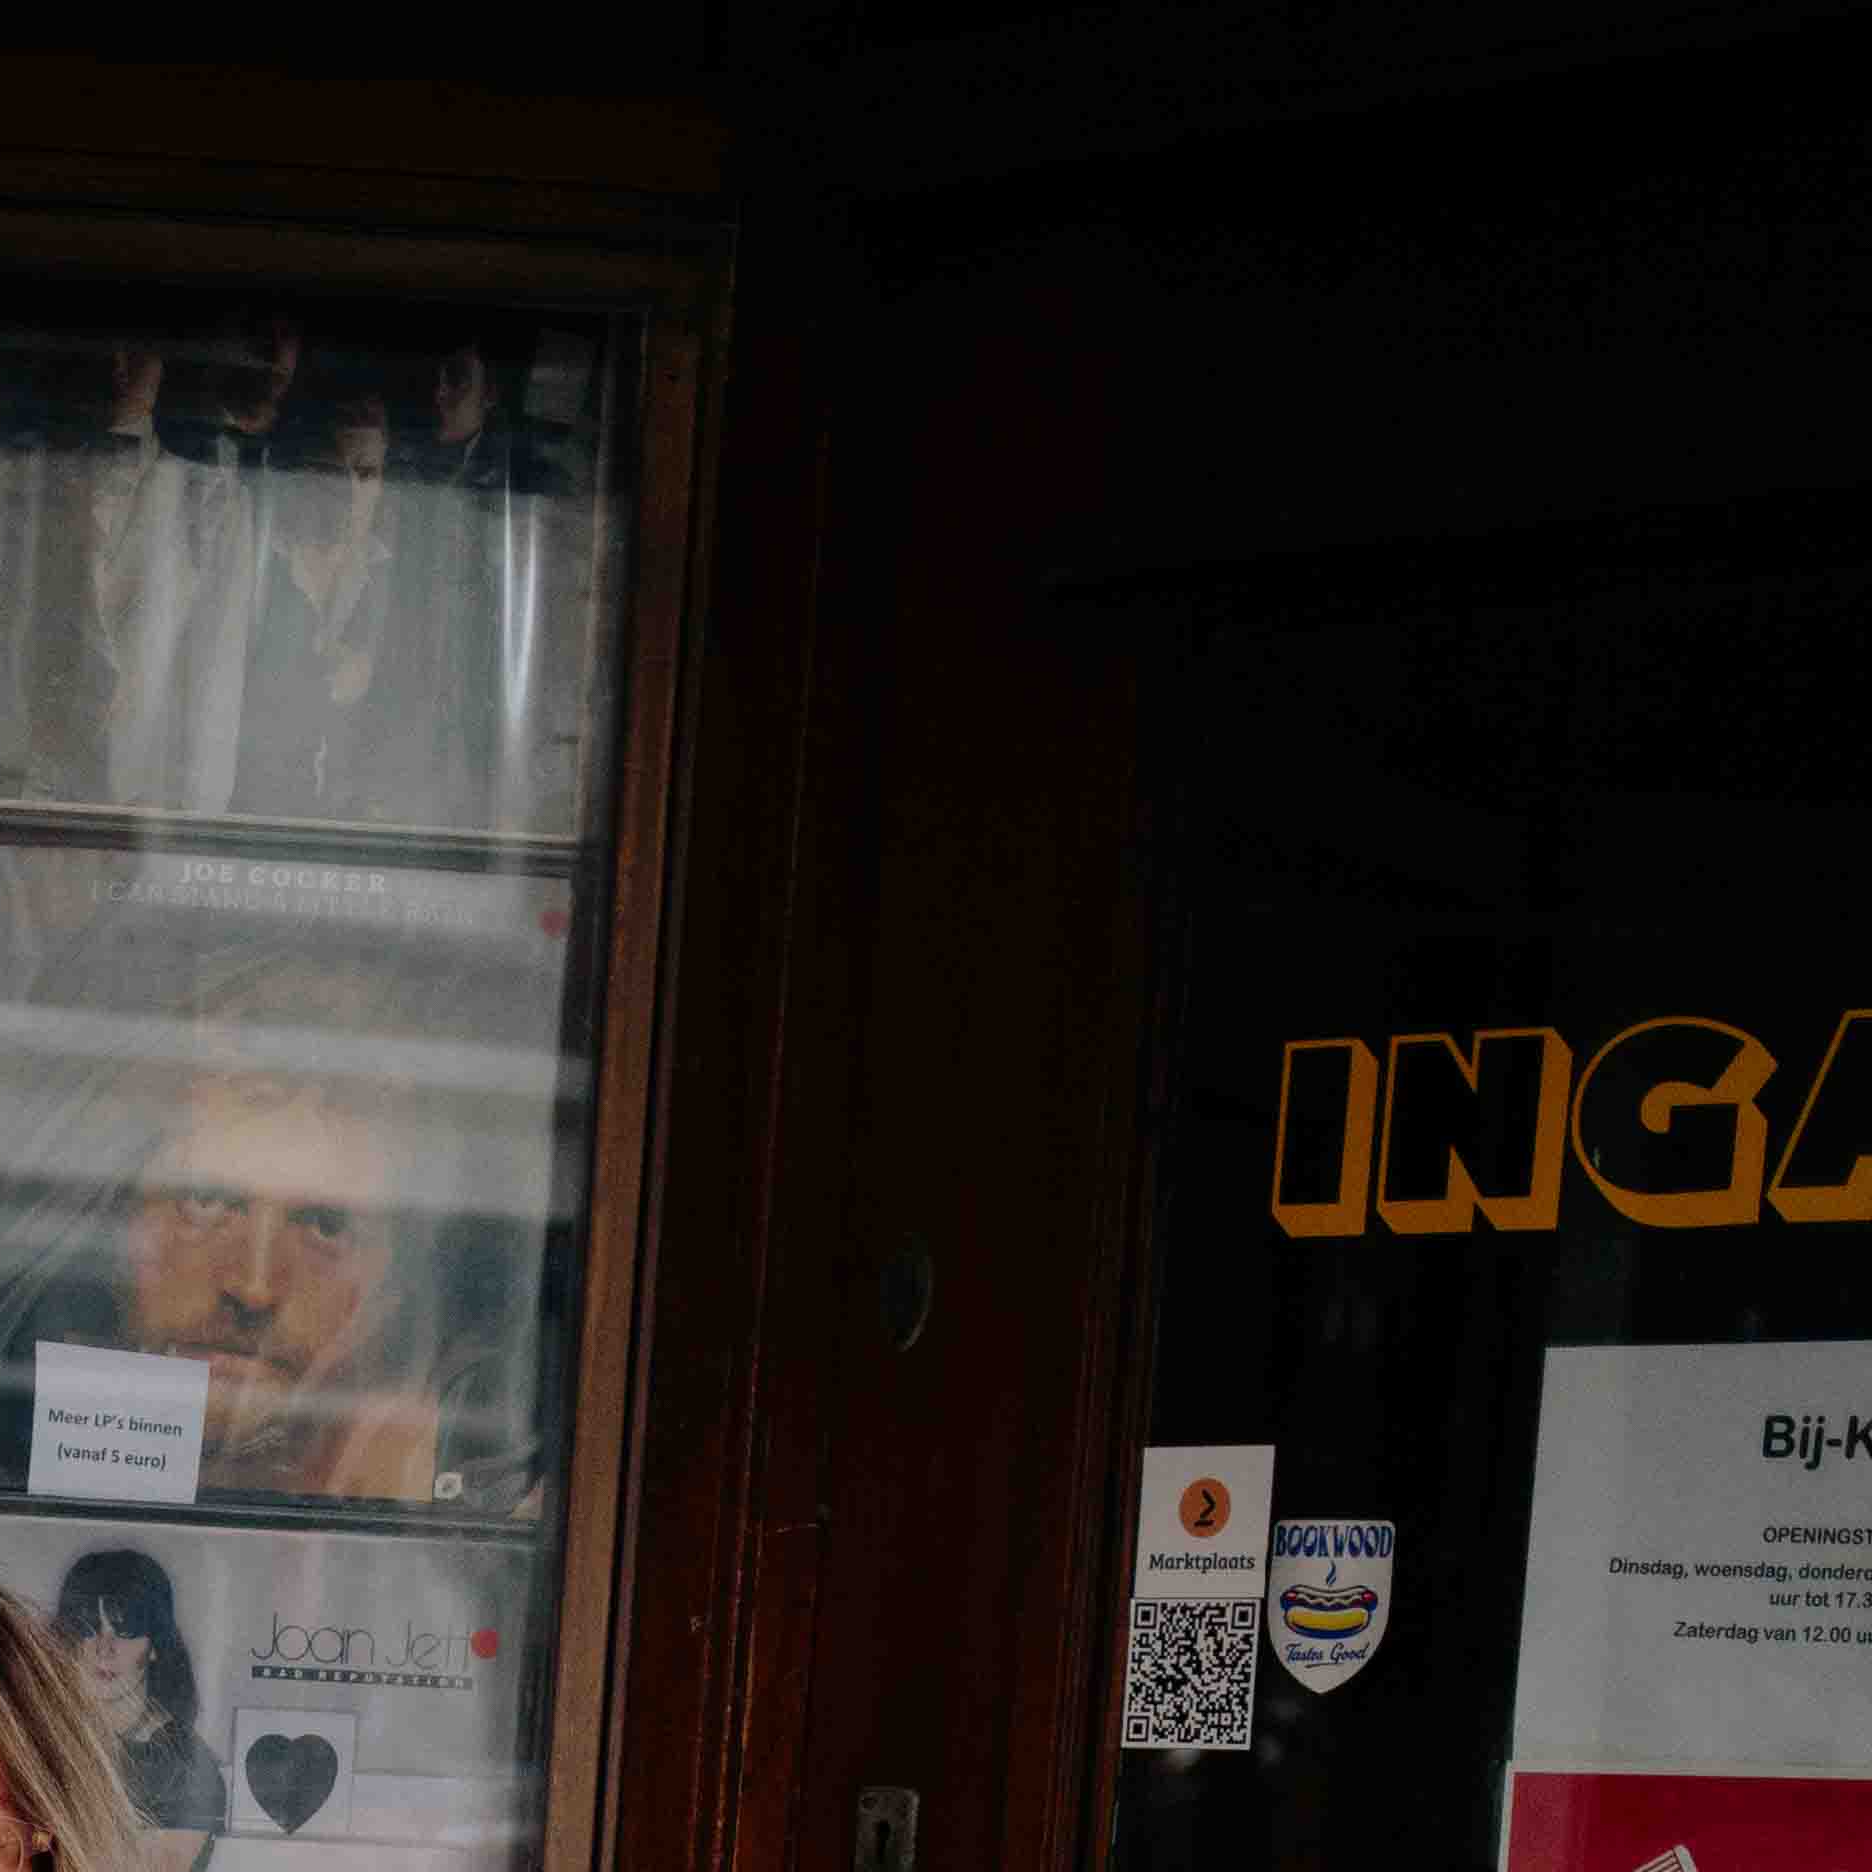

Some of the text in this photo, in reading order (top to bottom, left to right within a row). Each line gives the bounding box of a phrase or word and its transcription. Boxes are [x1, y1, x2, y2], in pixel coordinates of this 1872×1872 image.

[179, 859, 387, 895] JOE COCKER
[48, 1408, 184, 1438] Meer LP's binnen
[57, 1441, 167, 1471] (vanaf 5 euro)
[1762, 1414, 1872, 1471] Bij-K
[1148, 1553, 1256, 1574] Marktplaats
[1609, 1556, 1689, 1580] Dinsdag,
[1695, 1561, 1793, 1583] woensdag,
[1769, 1591, 1801, 1608] uur
[1805, 1590, 1830, 1608] tot
[250, 1612, 474, 1673] Joan Jett
[1673, 1621, 1760, 1645] Zaterdag
[1764, 1626, 1796, 1642] van
[1803, 1625, 1852, 1645] 12.00
[1330, 1641, 1371, 1664] Good
